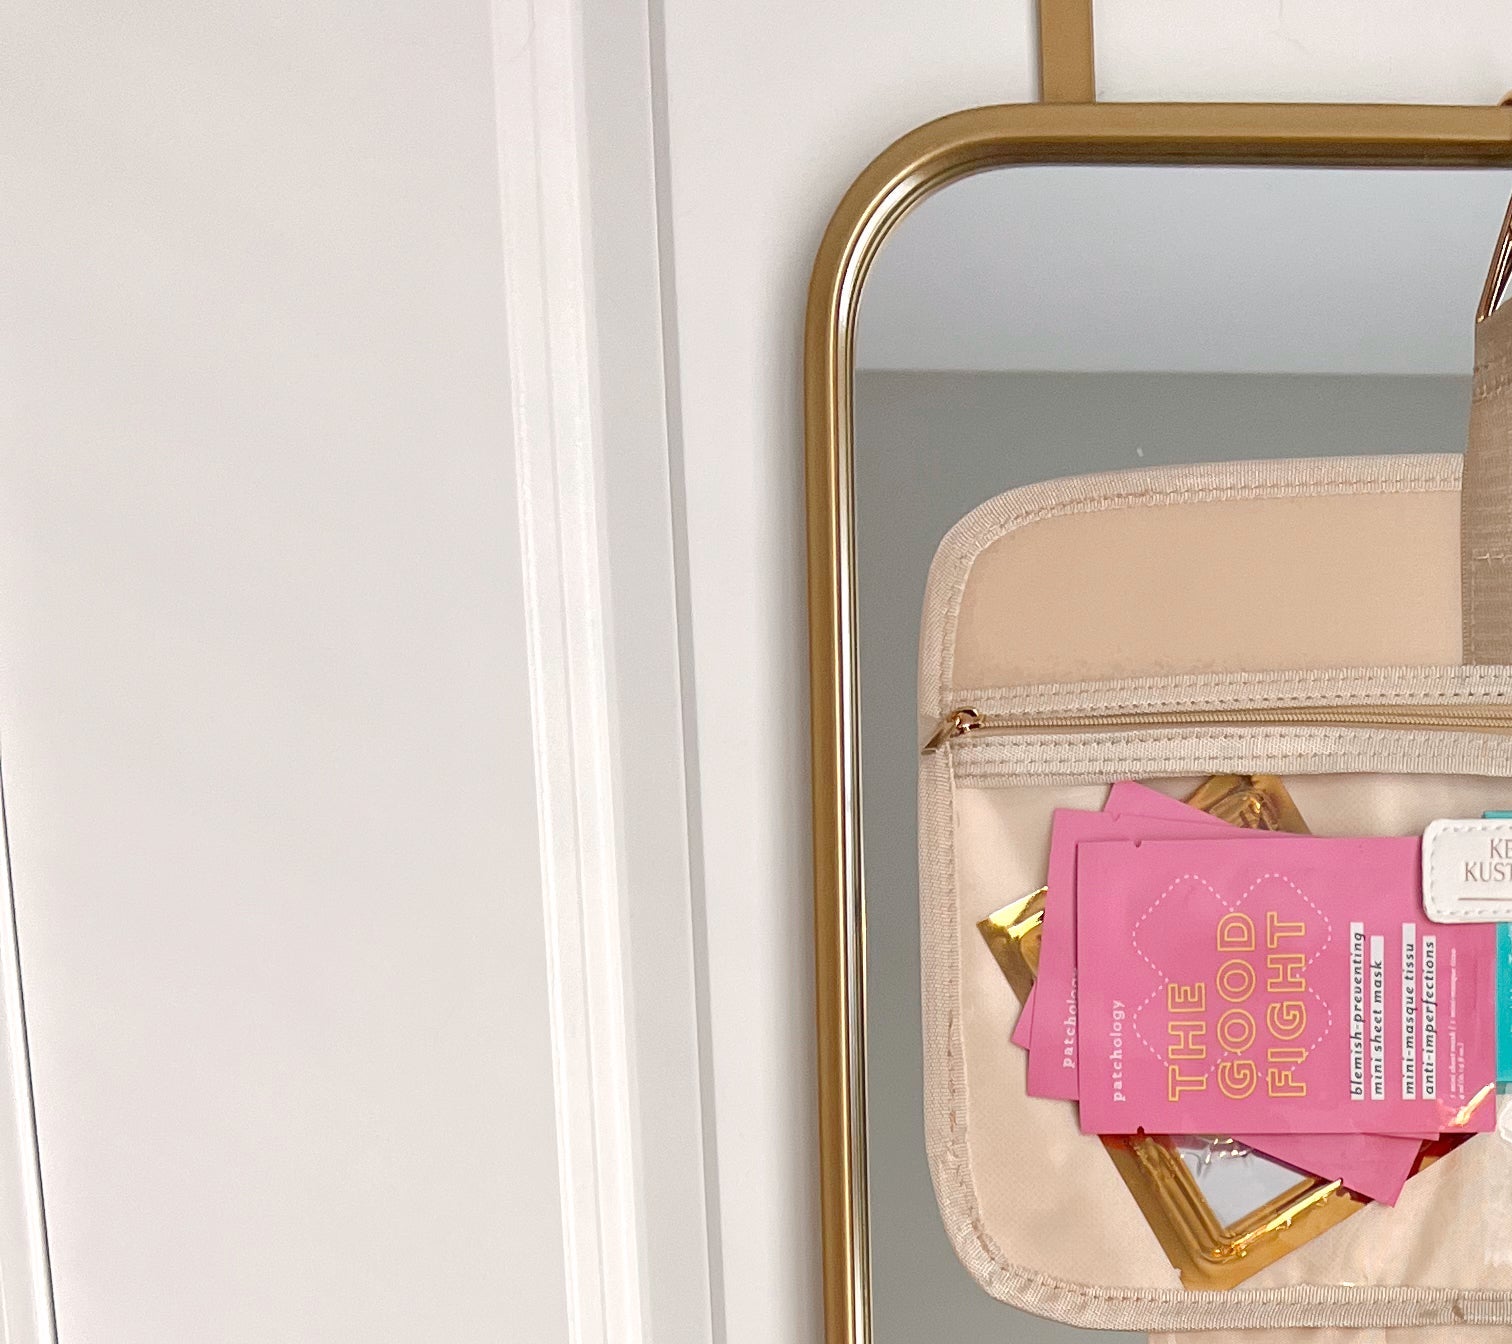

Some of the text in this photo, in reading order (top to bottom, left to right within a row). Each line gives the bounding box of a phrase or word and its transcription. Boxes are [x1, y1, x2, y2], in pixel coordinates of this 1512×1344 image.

[1062, 968, 1077, 1069] patchol
[1109, 1000, 1126, 1102] patchology
[1167, 981, 1207, 1102] THE
[1216, 912, 1257, 1100] GOOD
[1266, 911, 1307, 1098] FIGHT
[1349, 931, 1366, 1096] blemish-preventing
[1369, 960, 1383, 1096] mini sheet mask
[1402, 943, 1418, 1096] mini-masque tissu
[1420, 941, 1438, 1095] anti-imperfections
